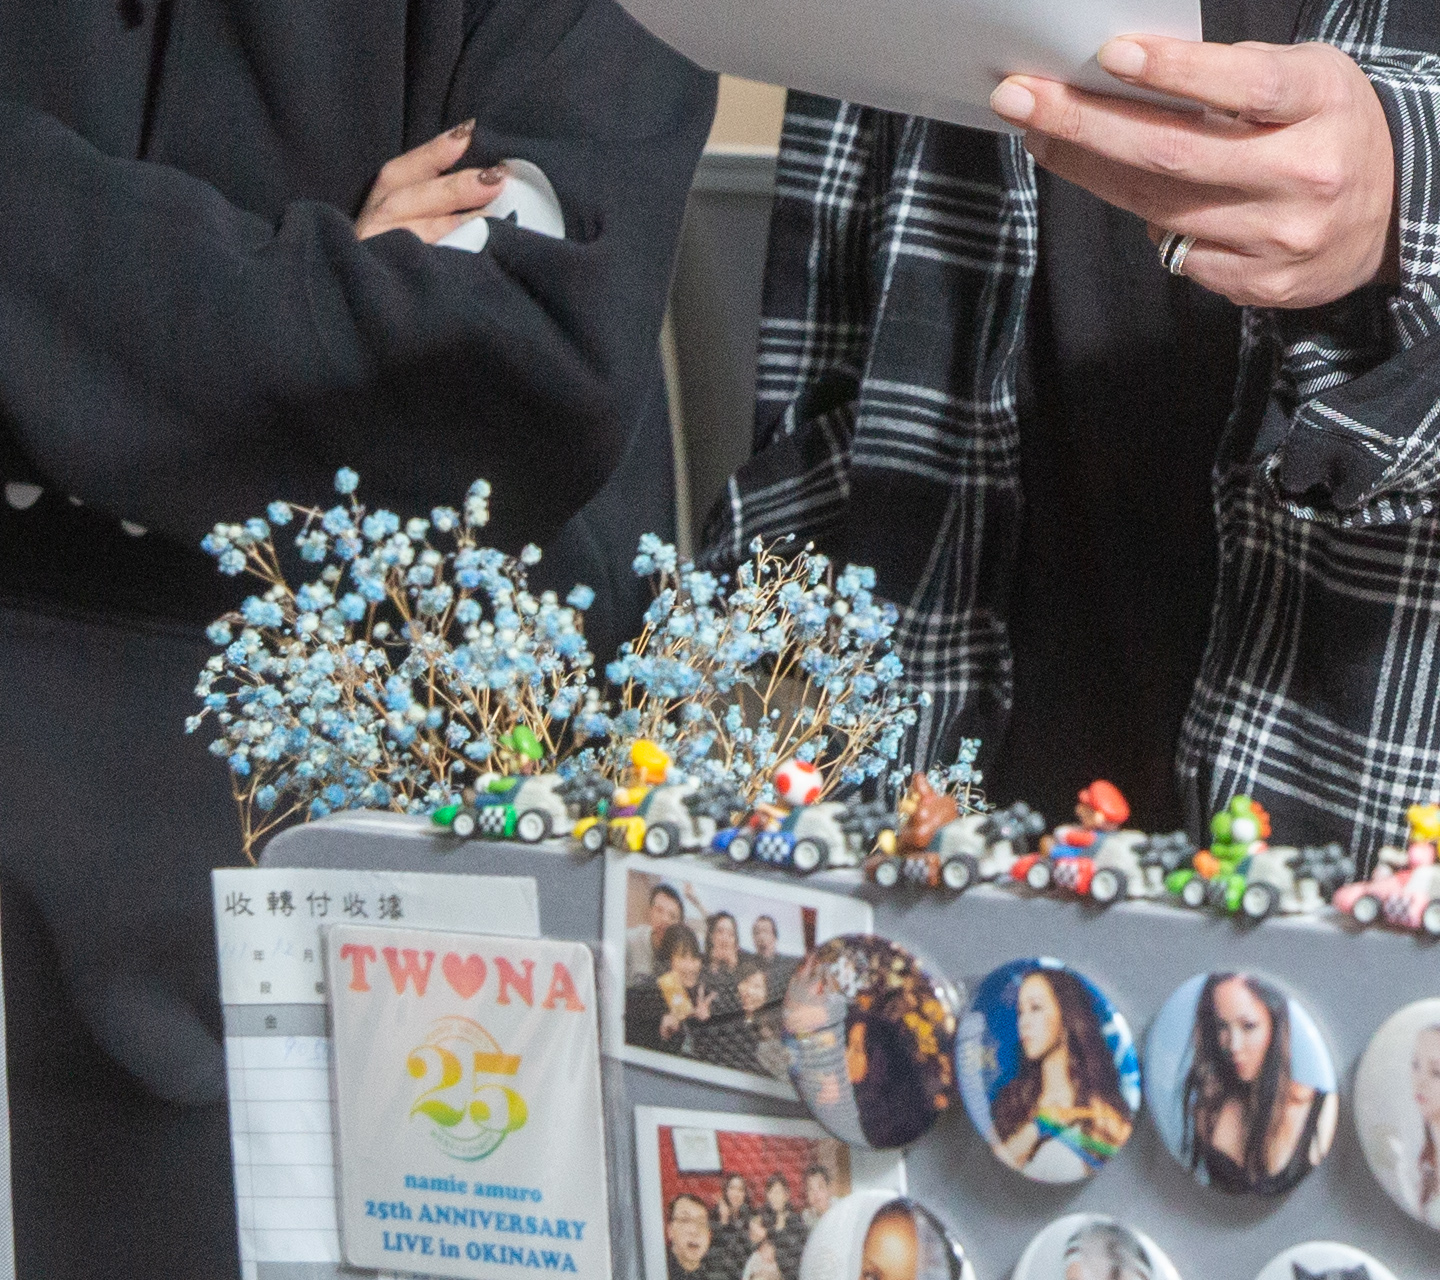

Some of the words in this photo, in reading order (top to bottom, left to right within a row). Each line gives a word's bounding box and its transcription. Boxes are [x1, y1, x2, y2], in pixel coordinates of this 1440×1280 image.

[406, 1043, 529, 1134] 25
[404, 1174, 468, 1194] namie
[473, 1180, 543, 1203] amuro
[365, 1199, 413, 1221] 25th
[418, 1203, 587, 1240] ANNIVERSARY
[382, 1230, 435, 1256] LIVE
[439, 1237, 461, 1258] in
[465, 1241, 578, 1273] OKINAWA
